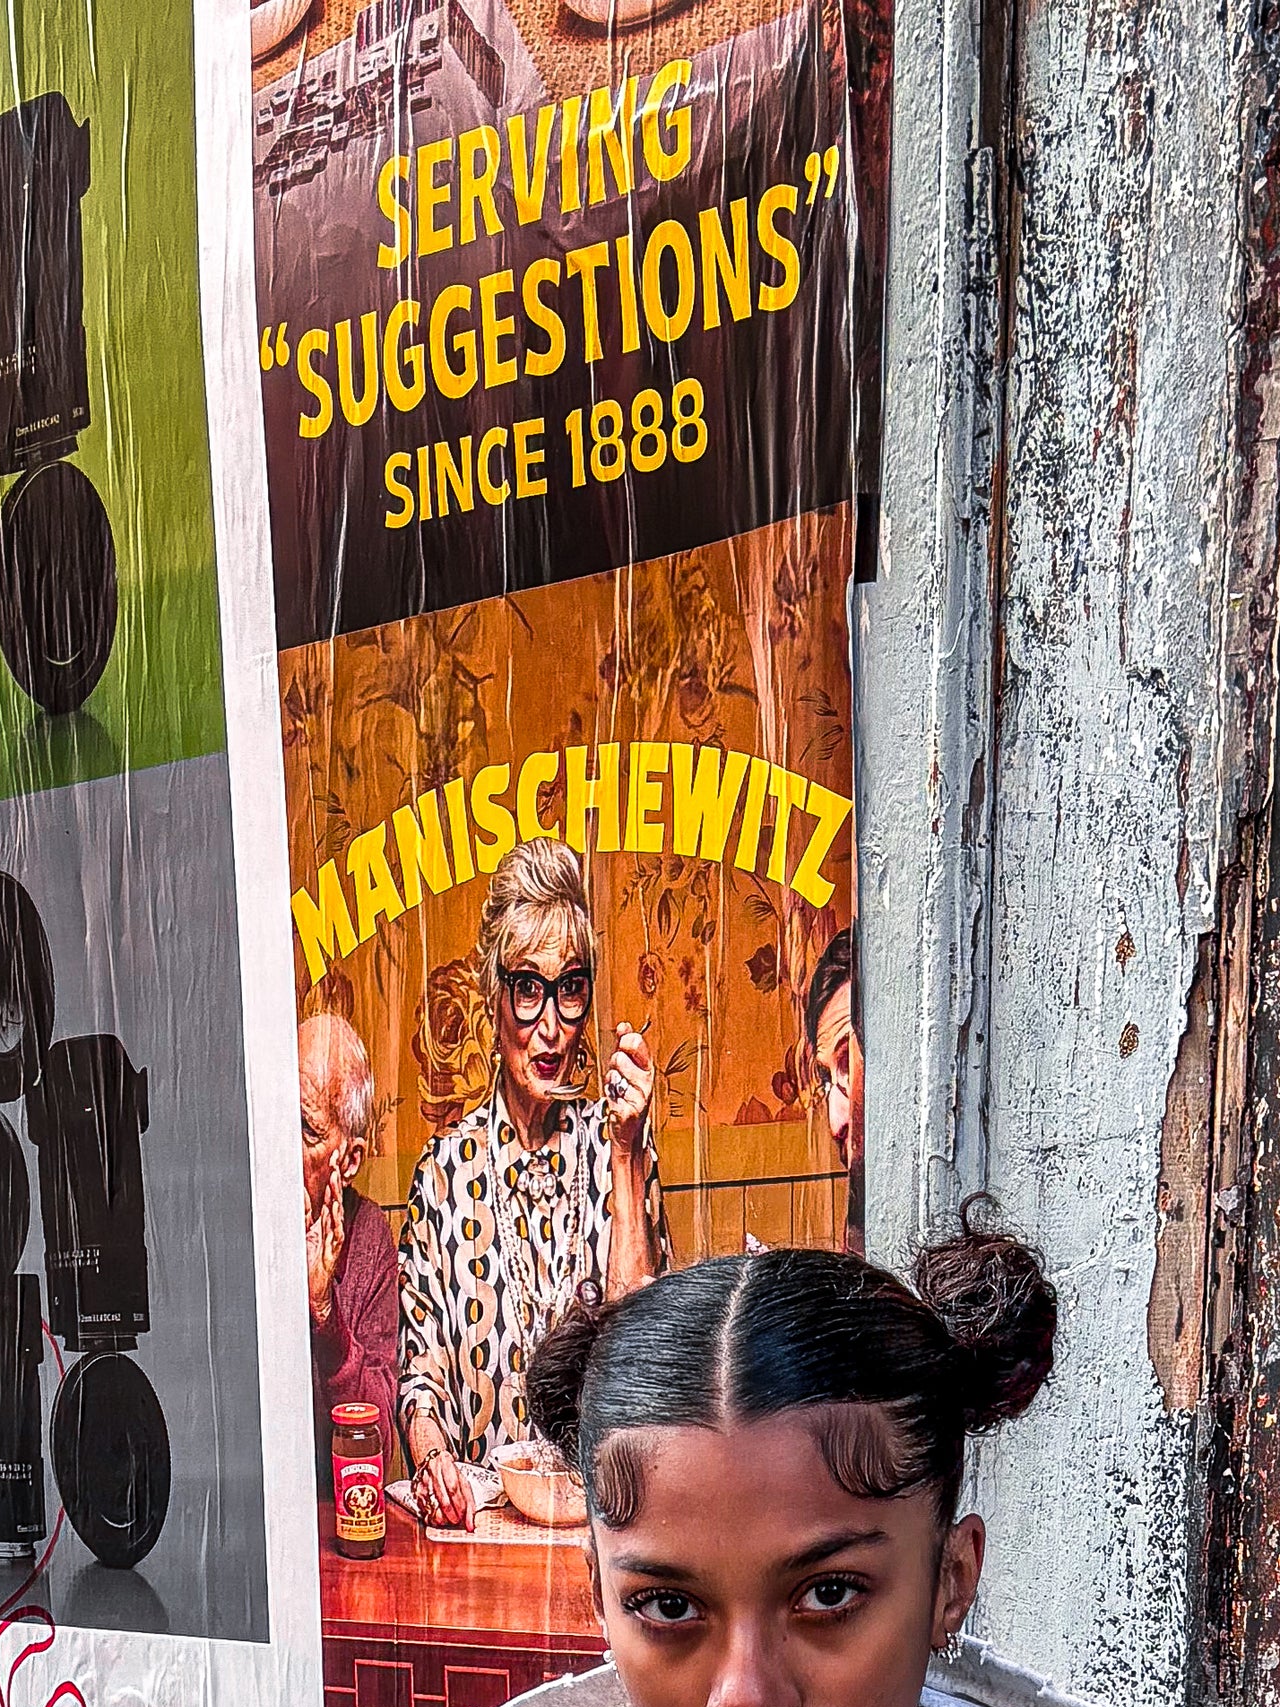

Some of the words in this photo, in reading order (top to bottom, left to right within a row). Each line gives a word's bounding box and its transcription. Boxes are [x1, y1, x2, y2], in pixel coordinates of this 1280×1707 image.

[377, 59, 692, 270] SERVING
[383, 418, 547, 529] SINCE
[565, 377, 708, 488] 1888
[292, 742, 853, 986] MANISCHEWITZ
